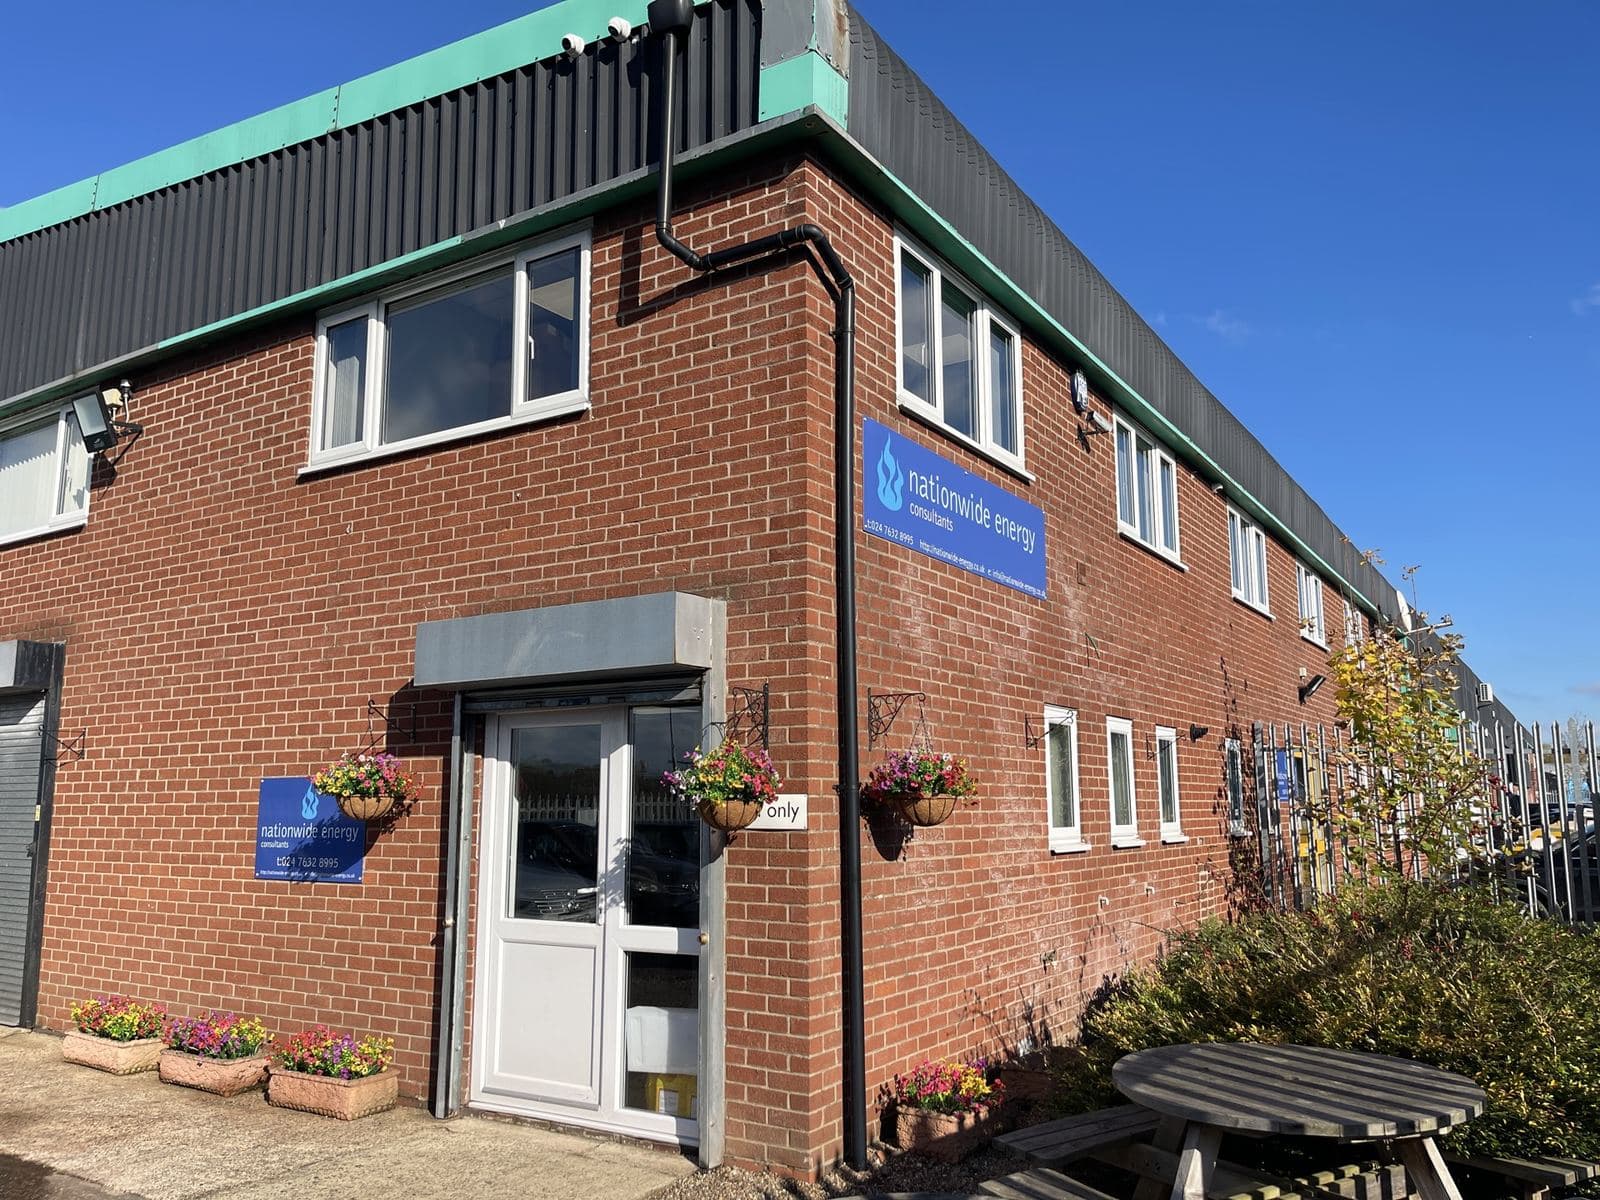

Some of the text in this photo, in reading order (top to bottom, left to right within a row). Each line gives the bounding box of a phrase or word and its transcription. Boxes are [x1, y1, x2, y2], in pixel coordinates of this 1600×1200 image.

[909, 469, 1036, 554] nationwide energy
[909, 501, 954, 532] consultants
[884, 525, 899, 539] 7632
[899, 531, 914, 545] 8995
[767, 801, 800, 823] only
[261, 822, 359, 841] nationwide energy
[260, 840, 289, 848] consultants
[298, 856, 317, 868] 7632
[318, 857, 339, 868] 8995
